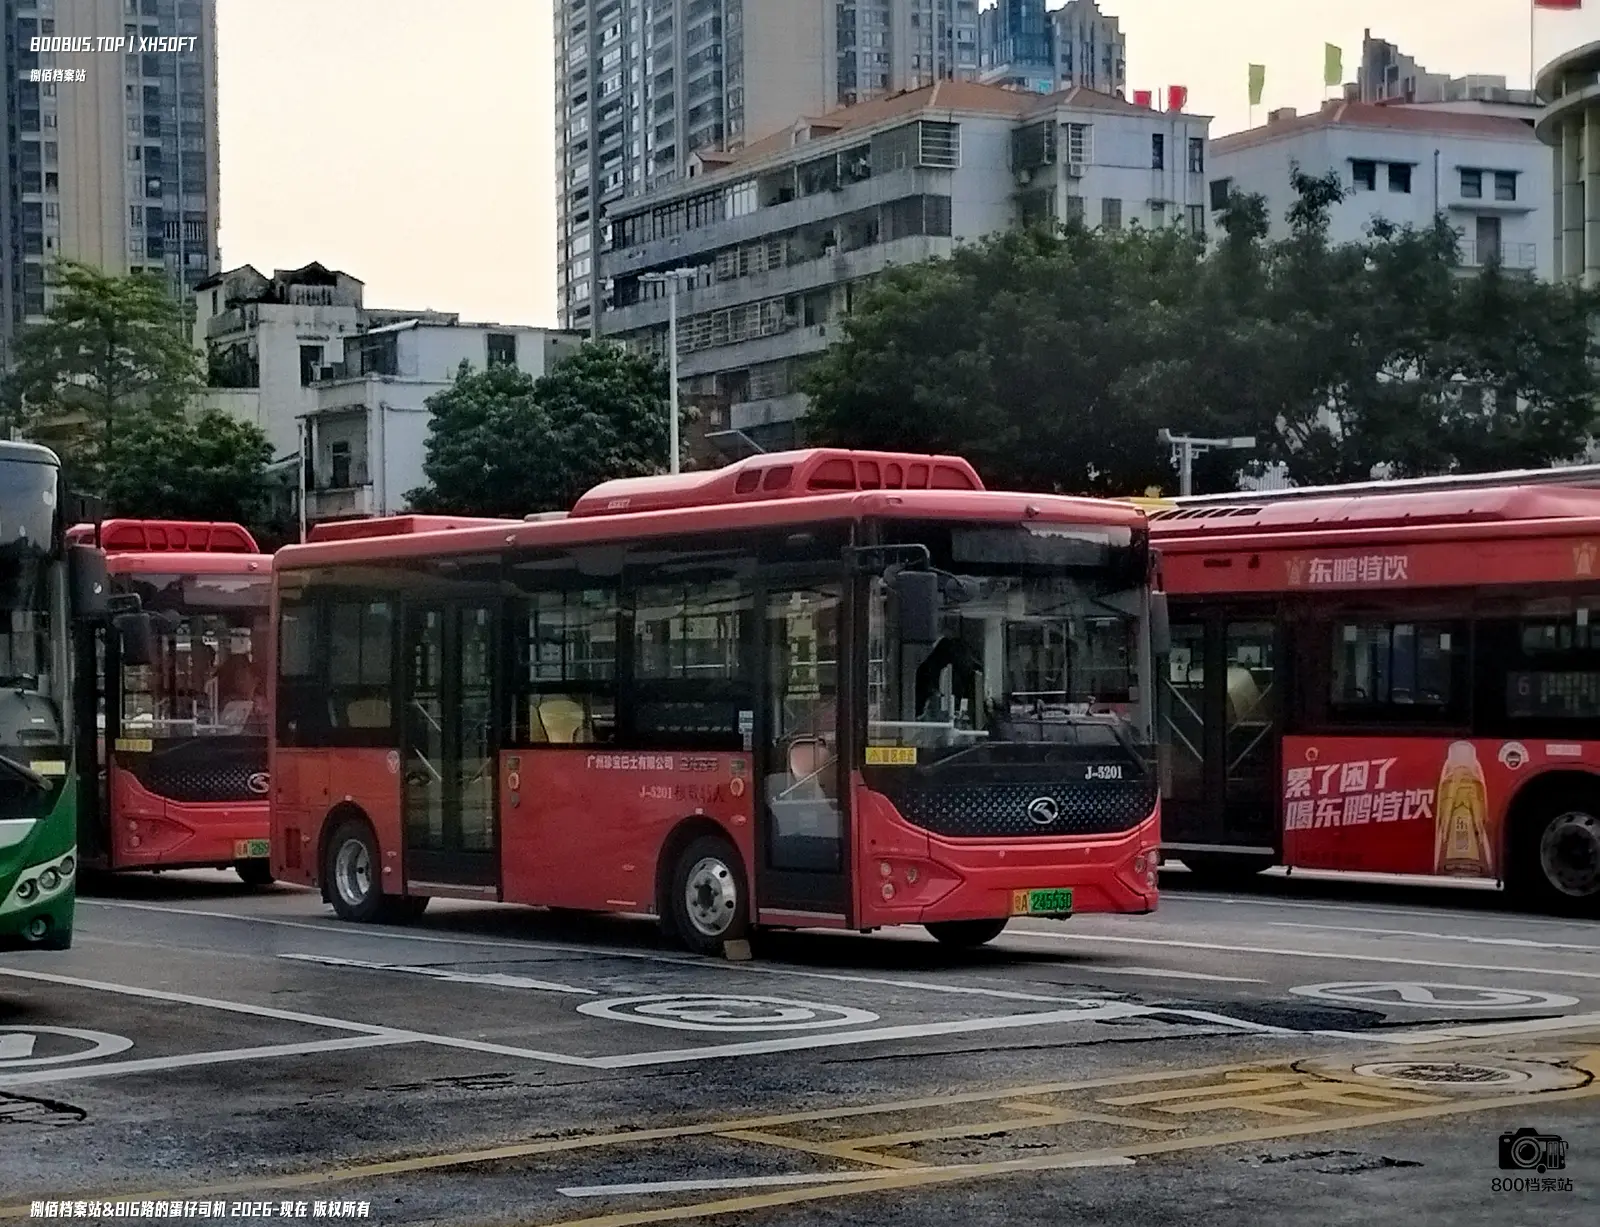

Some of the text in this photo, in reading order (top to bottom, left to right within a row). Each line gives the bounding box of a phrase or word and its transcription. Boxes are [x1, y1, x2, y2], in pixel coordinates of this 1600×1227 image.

[1308, 556, 1409, 584] 东鹏特饮
[587, 755, 674, 771] 广州珍宝巴士有限公司
[1084, 765, 1124, 780] J-5201
[1285, 757, 1398, 799] 累了困了
[639, 785, 673, 799] J-5201
[1285, 788, 1435, 831] 喝东鹏特饮
